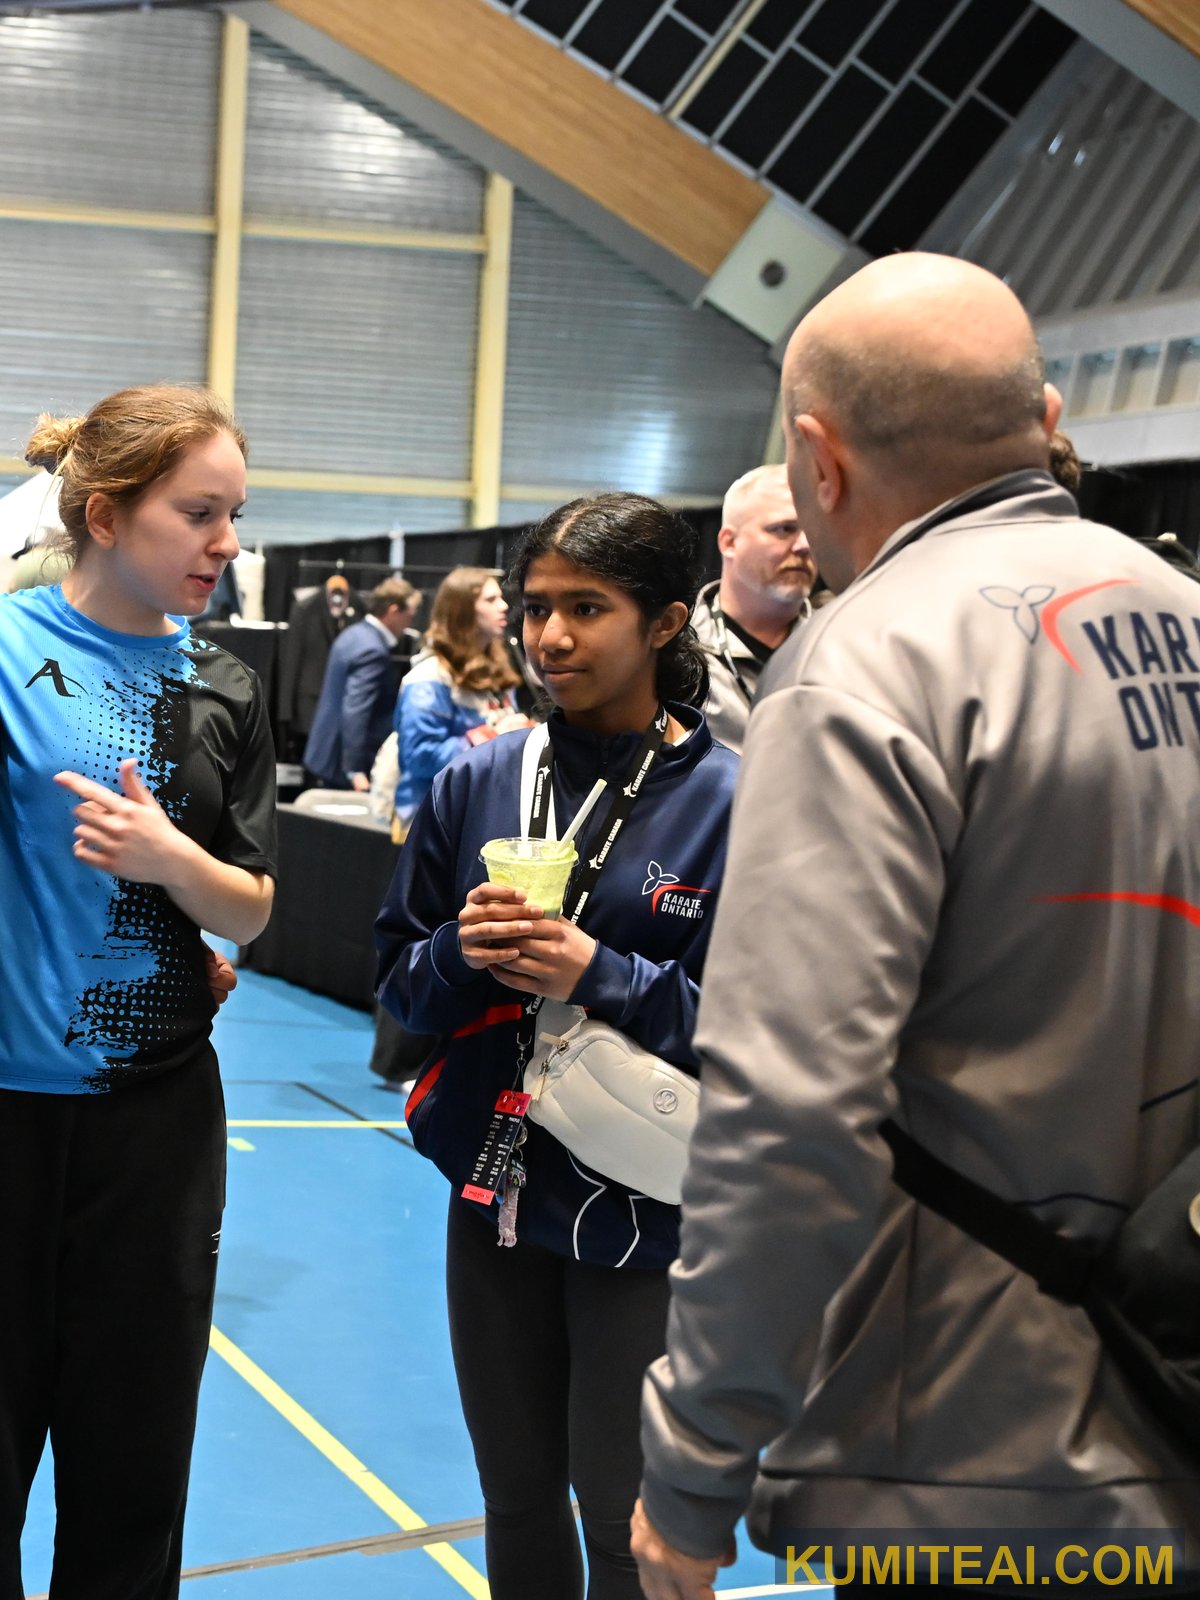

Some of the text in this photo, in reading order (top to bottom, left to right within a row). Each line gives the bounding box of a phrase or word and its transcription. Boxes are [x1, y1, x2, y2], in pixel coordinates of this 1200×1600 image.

[631, 749, 655, 792] KARATE CANADA
[597, 818, 623, 864] KARATE CANADA
[574, 891, 589, 916] CANADA
[661, 902, 704, 919] ONTARIO
[664, 892, 701, 910] KARATE
